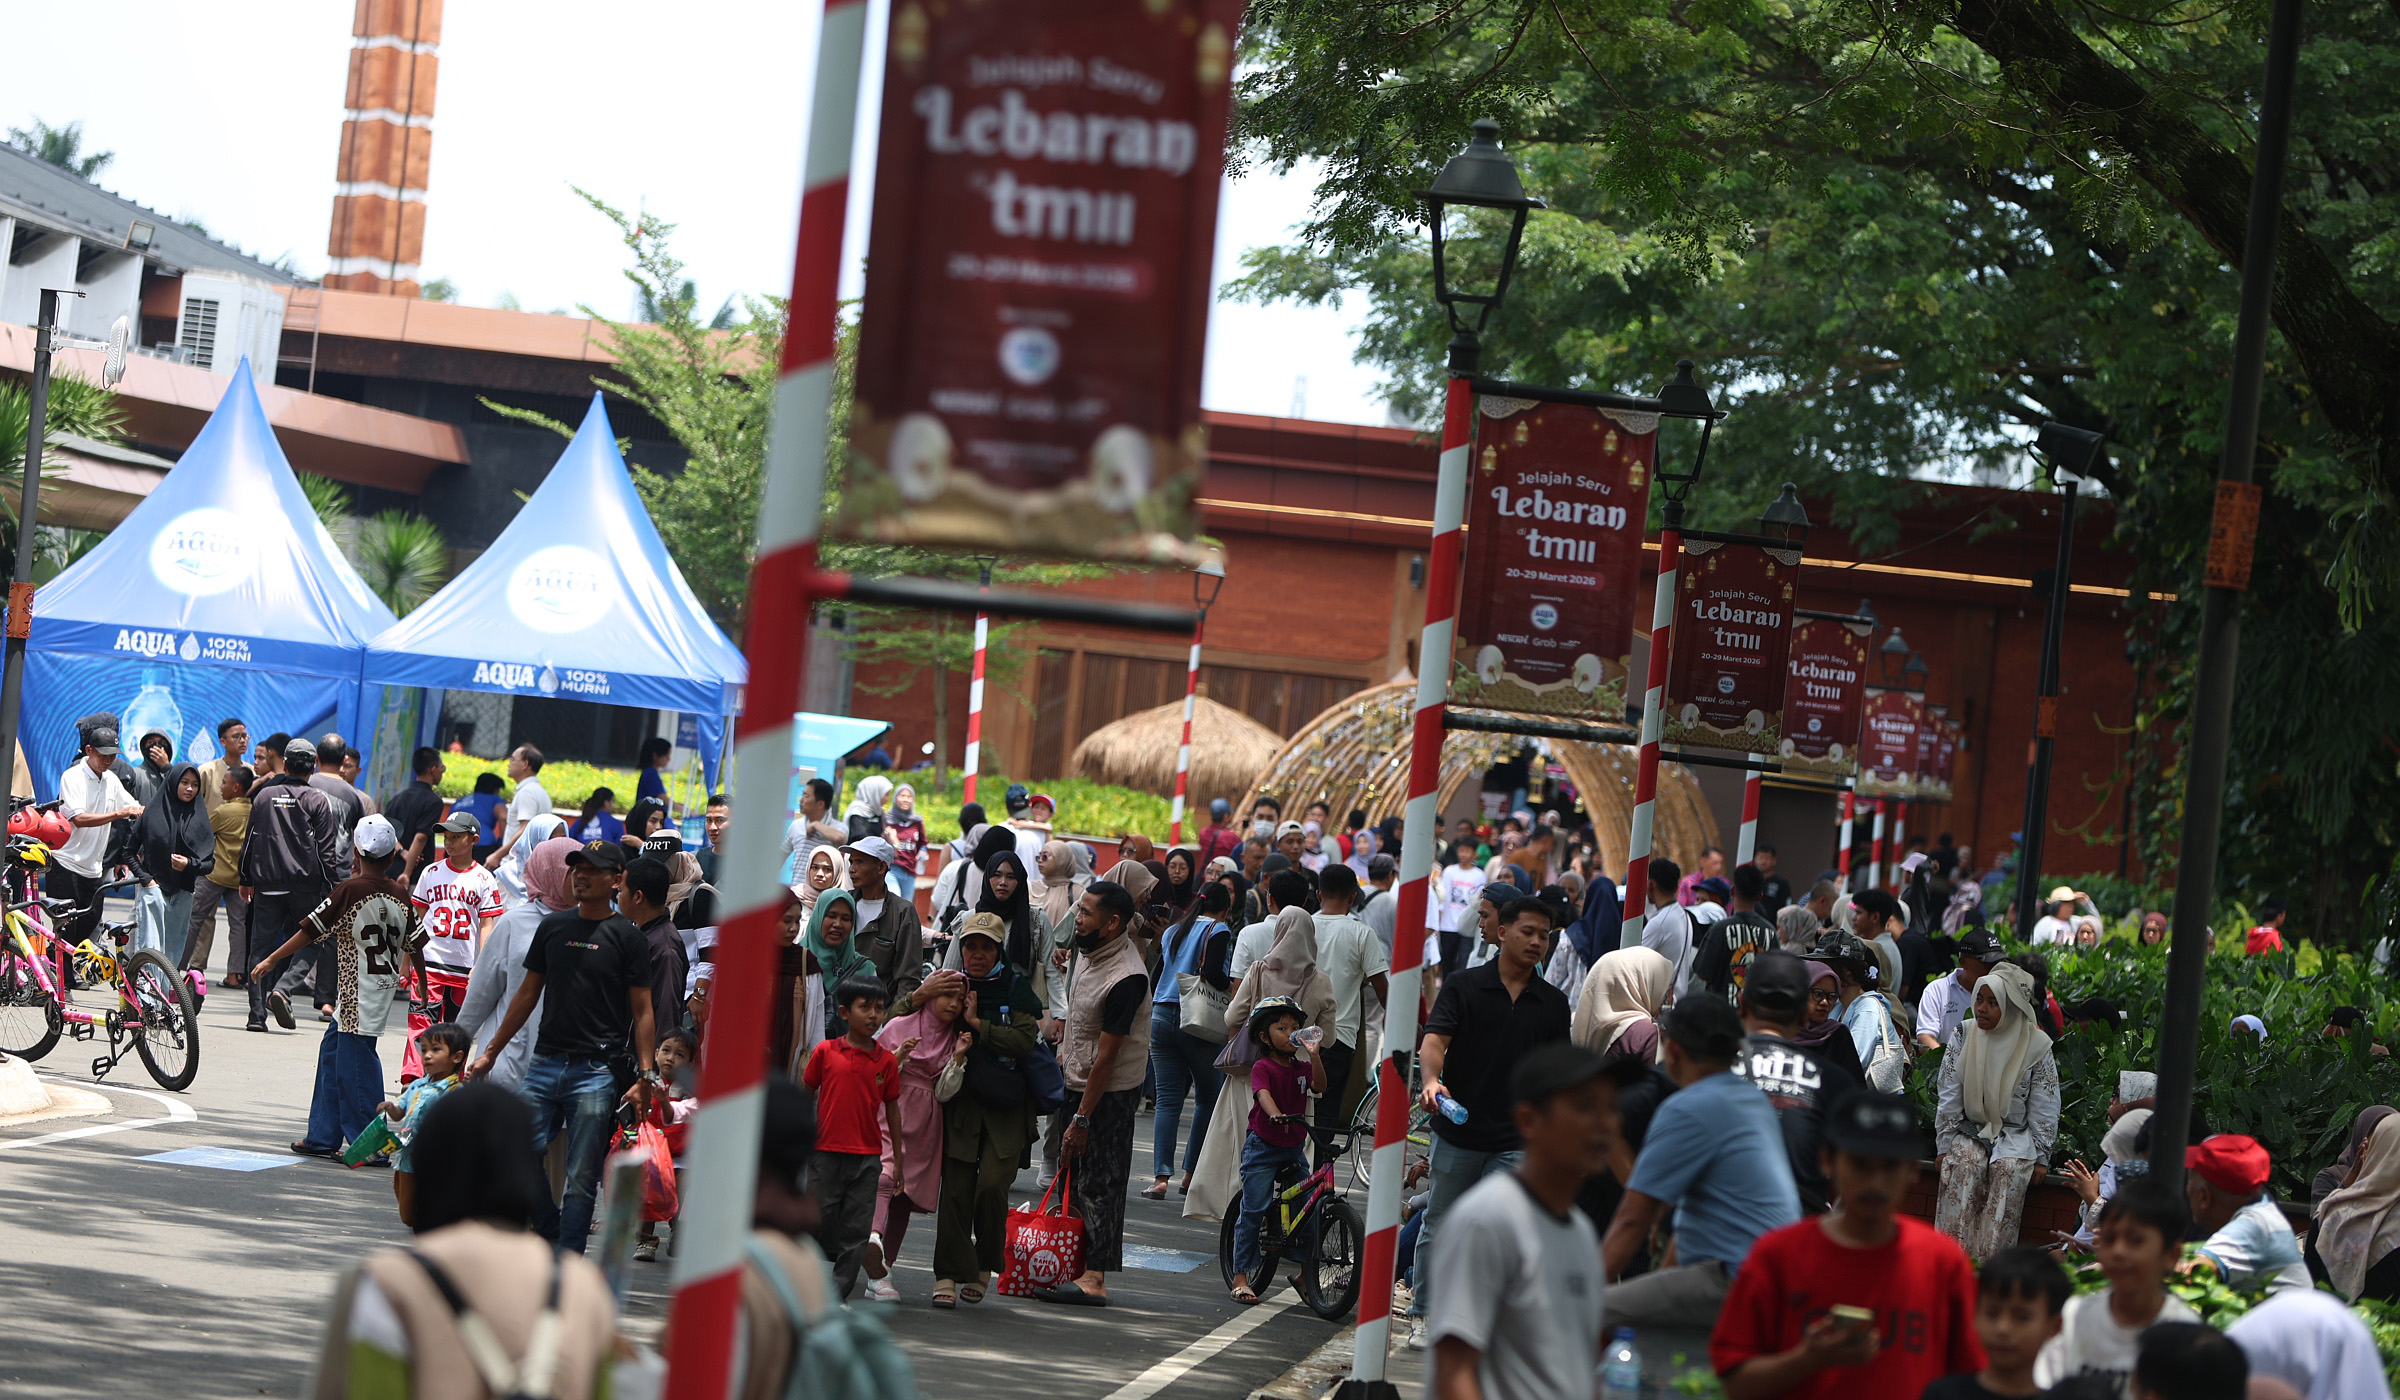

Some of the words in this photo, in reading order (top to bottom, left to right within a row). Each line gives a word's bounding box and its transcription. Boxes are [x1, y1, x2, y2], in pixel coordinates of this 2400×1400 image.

[913, 84, 1198, 177] Lebaran
[1517, 471, 1573, 486] Jelajah
[1576, 475, 1612, 495] Seru
[1490, 486, 1627, 530] Lebaran
[1505, 568, 1538, 580] 20-29
[1538, 571, 1568, 583] Maret
[1569, 574, 1597, 586] 2026
[1709, 589, 1745, 600] Jelajah
[1747, 592, 1771, 605] Seru
[1691, 599, 1781, 628] Lebaran
[114, 629, 177, 657] AQUA
[207, 636, 250, 652] 100%
[1532, 637, 1558, 648] Grab
[202, 647, 252, 663] MURNI
[1701, 652, 1722, 661] 20-29
[1723, 655, 1742, 663] Maret
[1743, 656, 1761, 665] 2026
[473, 661, 536, 690] AQUA
[565, 669, 608, 685] 100%
[1789, 660, 1857, 684] Lebaran
[561, 679, 611, 696] MURNI
[433, 906, 473, 941] 32
[1018, 1226, 1039, 1238] YA!
[1032, 1264, 1057, 1278] YA!
